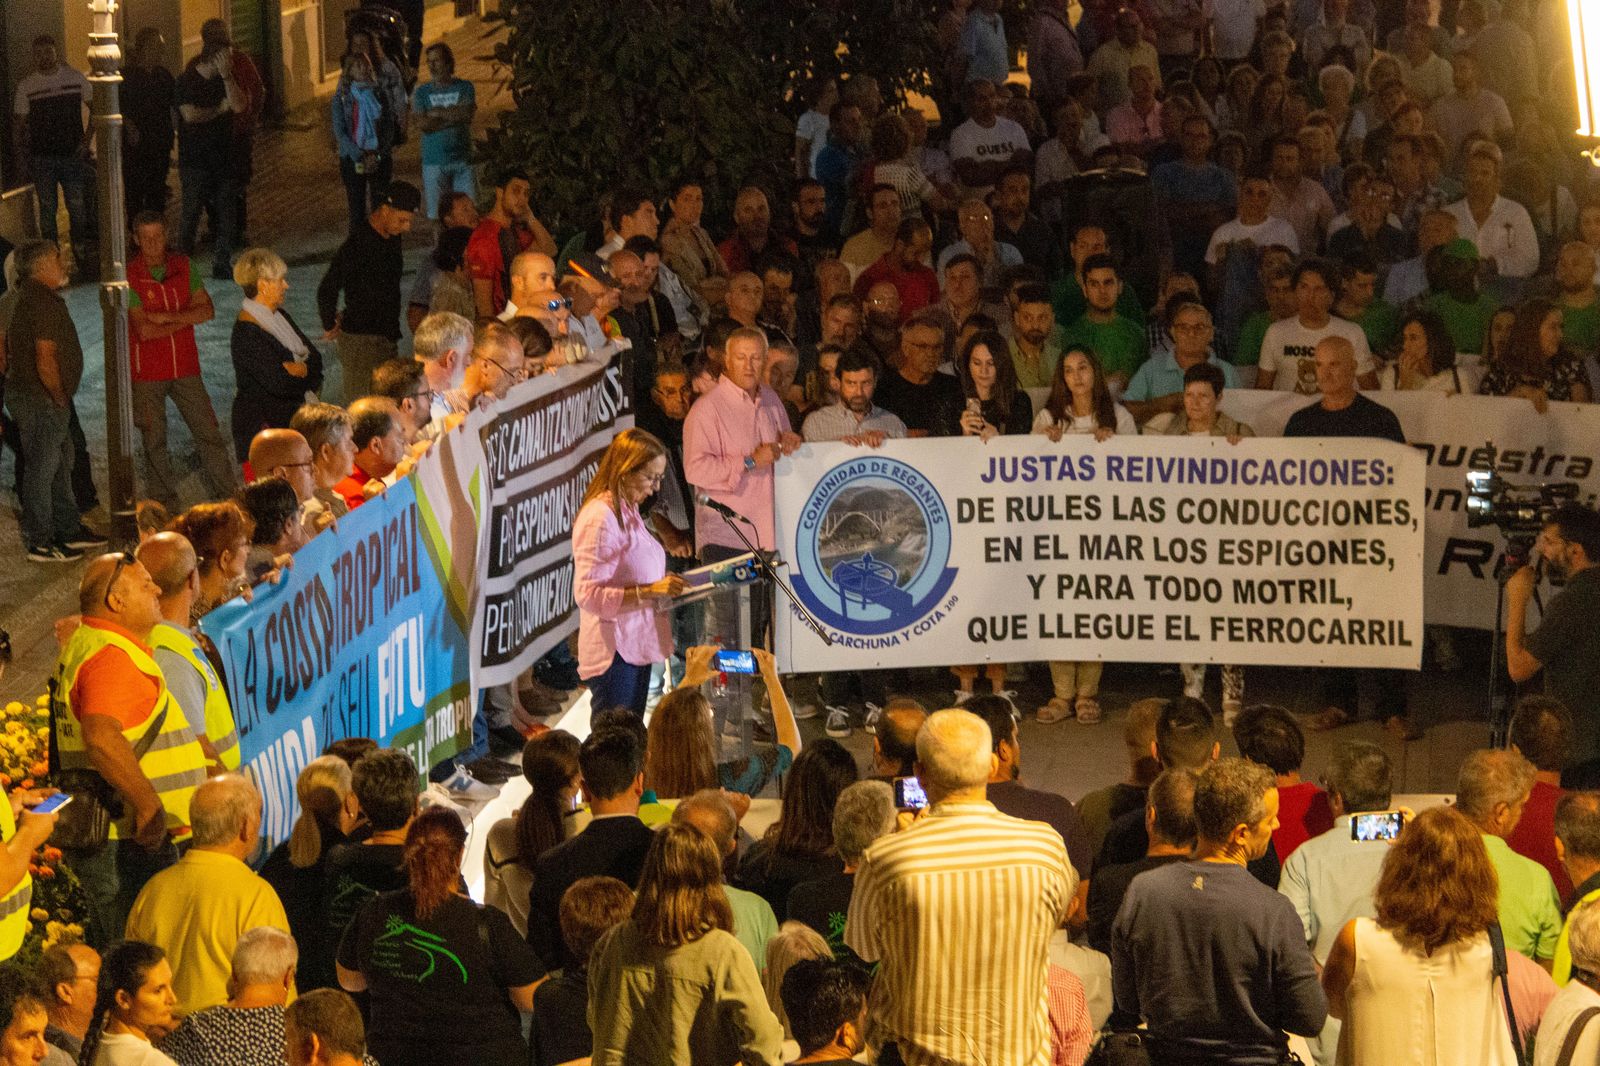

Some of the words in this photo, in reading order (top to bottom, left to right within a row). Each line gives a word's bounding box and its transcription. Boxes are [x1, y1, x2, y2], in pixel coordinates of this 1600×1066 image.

[980, 455, 1096, 483] JUSTAS
[1106, 455, 1394, 487] REIVINDICACIONES:
[803, 462, 867, 530] COMUNIDAD
[870, 461, 887, 475] DE
[890, 466, 944, 525] REGANTES
[957, 497, 995, 524] DE
[1006, 495, 1102, 523] RULES
[1112, 495, 1166, 524] LAS
[1176, 497, 1418, 532] CONDUCCIONES,
[515, 481, 571, 553] ESPIGONS
[984, 536, 1024, 563] EN
[1033, 534, 1069, 561] EL
[1079, 534, 1145, 562] MAR
[1153, 535, 1208, 565] LOS
[1218, 538, 1395, 572] ESPIGONES,
[1026, 574, 1046, 600] Y
[1057, 574, 1135, 601] PARA
[1143, 574, 1223, 604] TODO
[1232, 577, 1353, 611] MOTRIL,
[226, 626, 260, 738] LA
[264, 572, 334, 715] COSTA
[331, 502, 421, 655] TROPICAL
[483, 600, 515, 657] PER
[829, 631, 900, 650] CARCHUNA
[901, 630, 911, 642] Y
[913, 608, 946, 637] COTA
[967, 614, 1028, 644] QUE
[1038, 613, 1155, 641] LLEGUE
[1165, 614, 1201, 642] EL
[1210, 616, 1413, 647] FERROCARRIL
